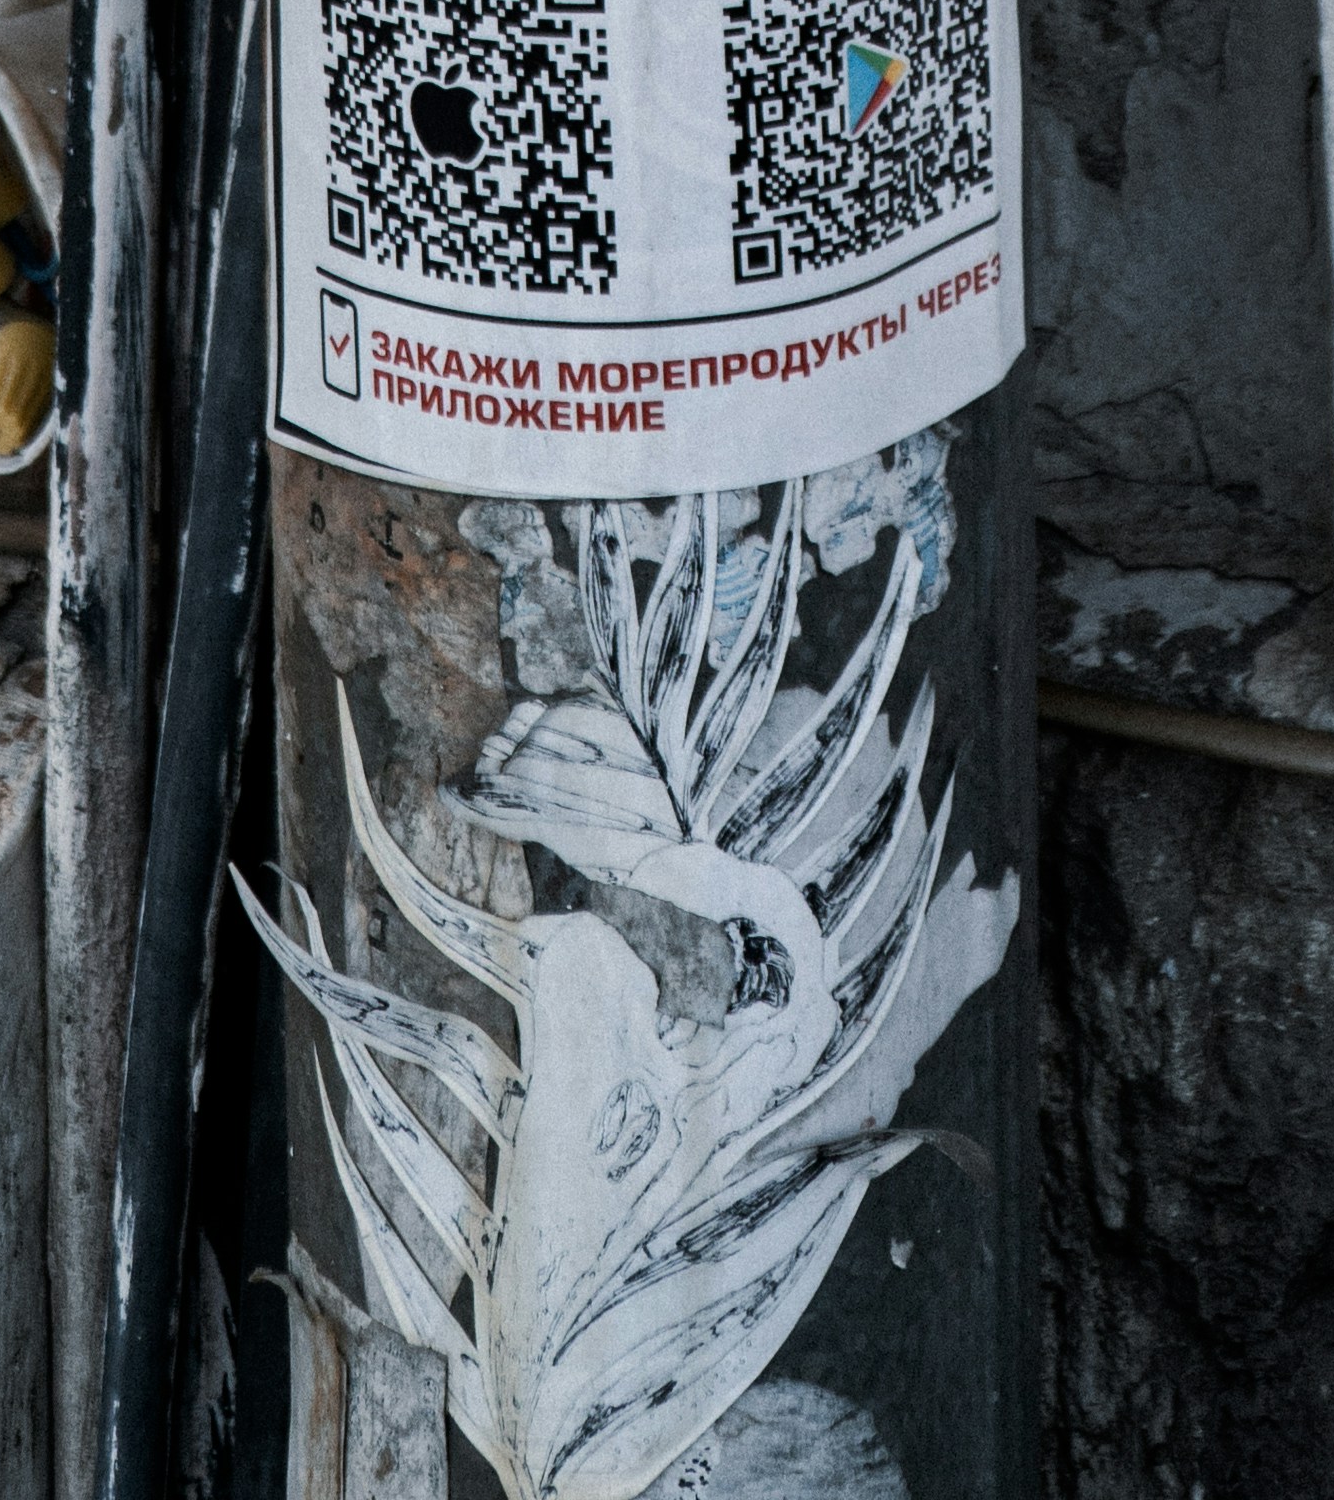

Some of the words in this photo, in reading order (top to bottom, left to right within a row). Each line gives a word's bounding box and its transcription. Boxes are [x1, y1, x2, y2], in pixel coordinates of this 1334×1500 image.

[369, 329, 542, 392] ЗАКАЖИ
[557, 312, 907, 395] МОРЕПРОДУКТЫ
[915, 251, 1004, 320] ЧЕРЕЗ
[371, 367, 665, 433] ПРИЛОЖЕНИЕ
